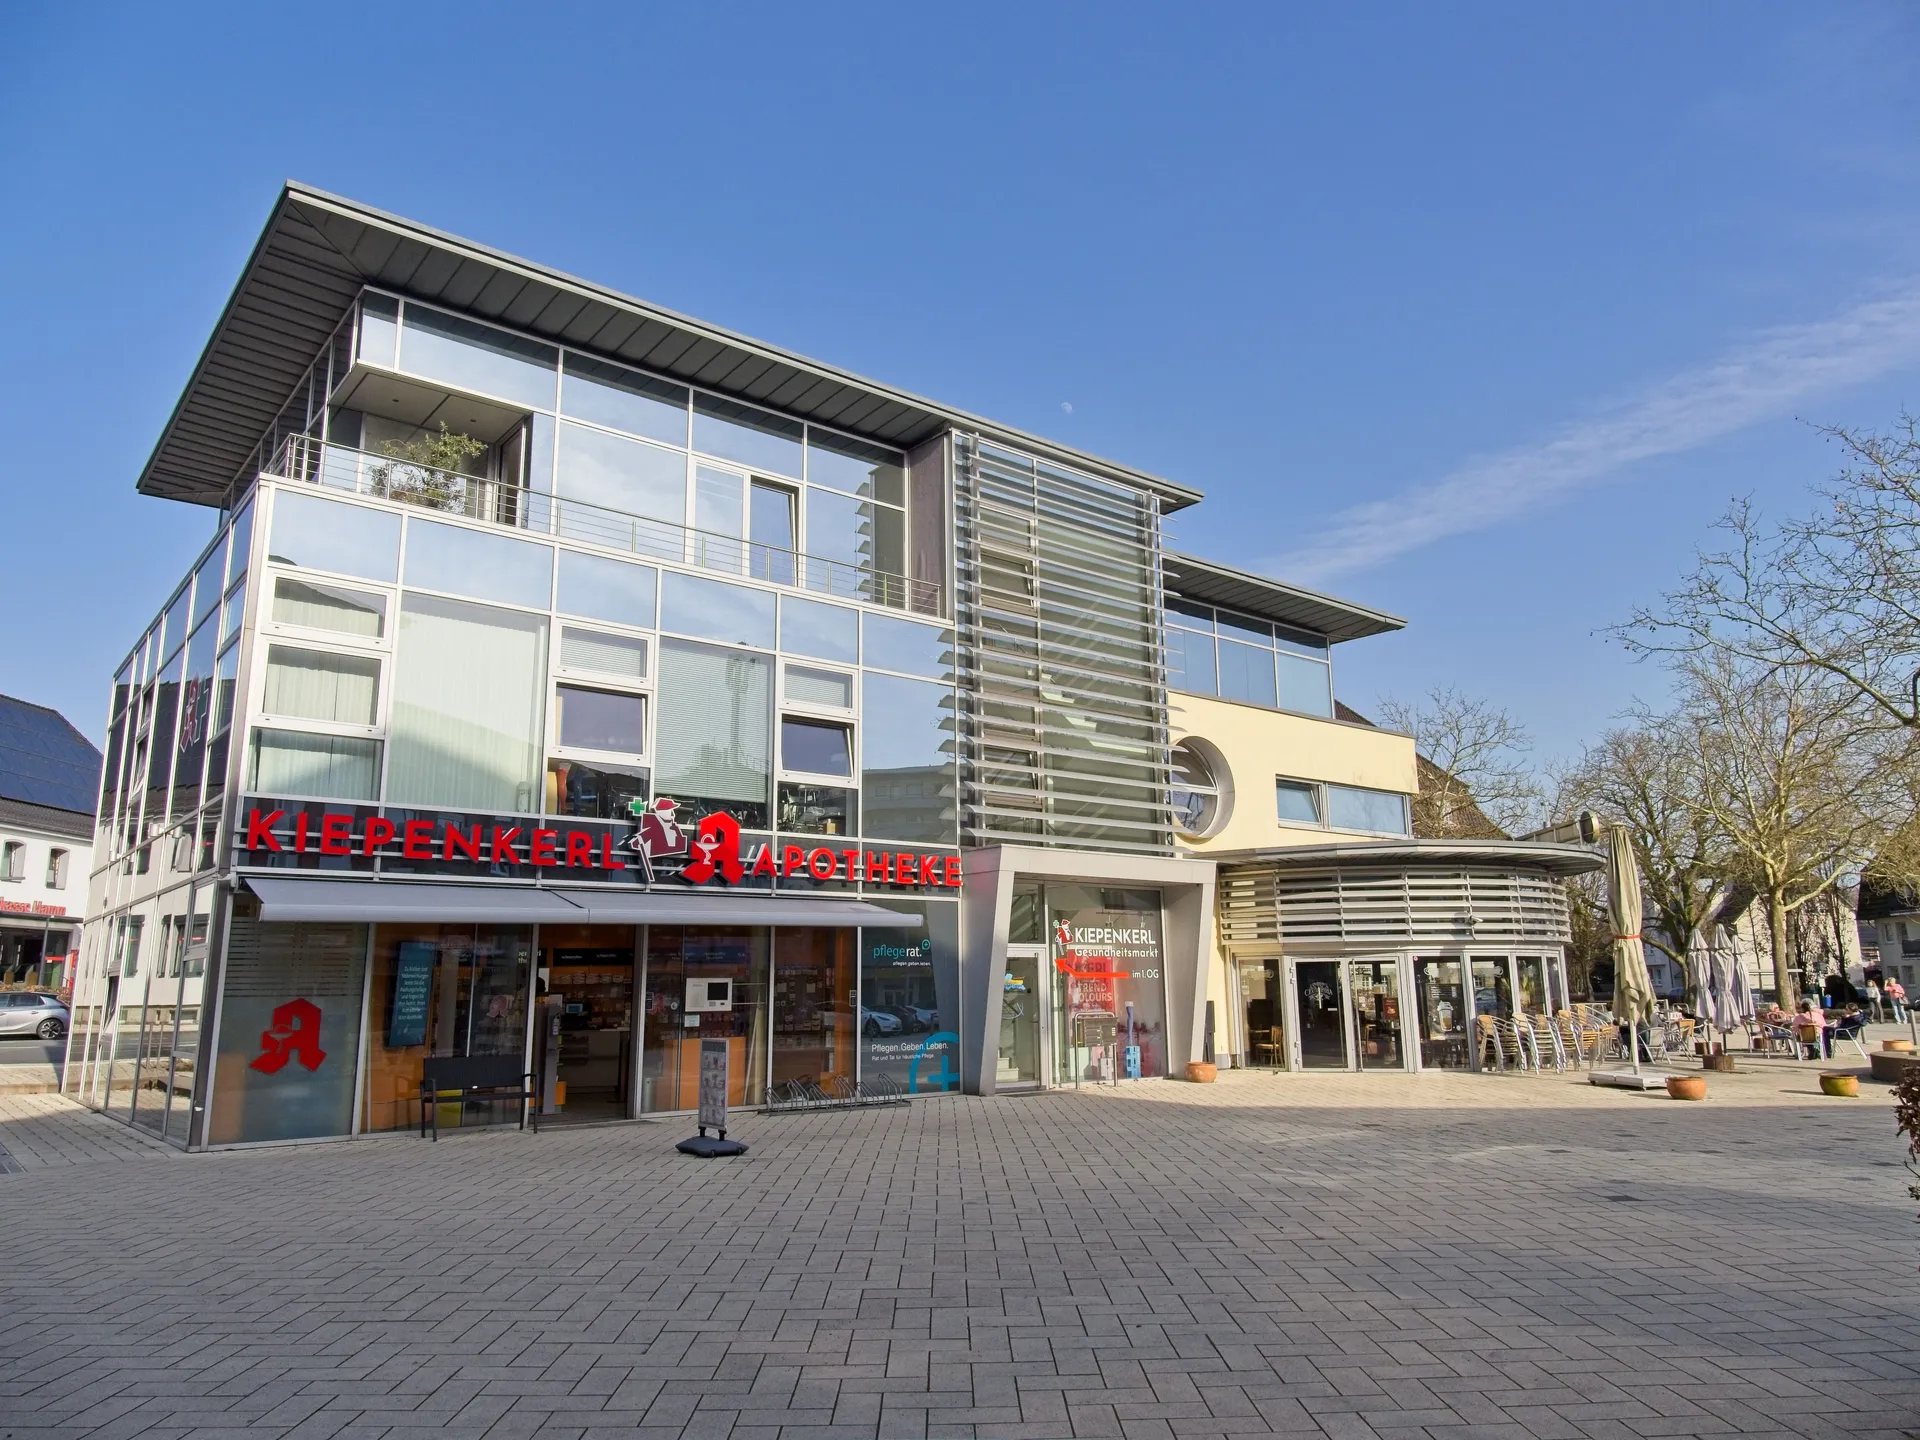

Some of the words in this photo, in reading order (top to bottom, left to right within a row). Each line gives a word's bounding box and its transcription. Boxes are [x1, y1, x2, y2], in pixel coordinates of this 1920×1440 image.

[246, 808, 626, 871] KIEPENKERL
[753, 843, 963, 887] APOTHEKE
[32, 901, 66, 916] Hamm
[1075, 928, 1156, 945] KIEPENKERL
[1074, 946, 1158, 958] Gesundheitsmarkt
[1132, 969, 1141, 978] im
[1077, 992, 1112, 1001] OLOURS
